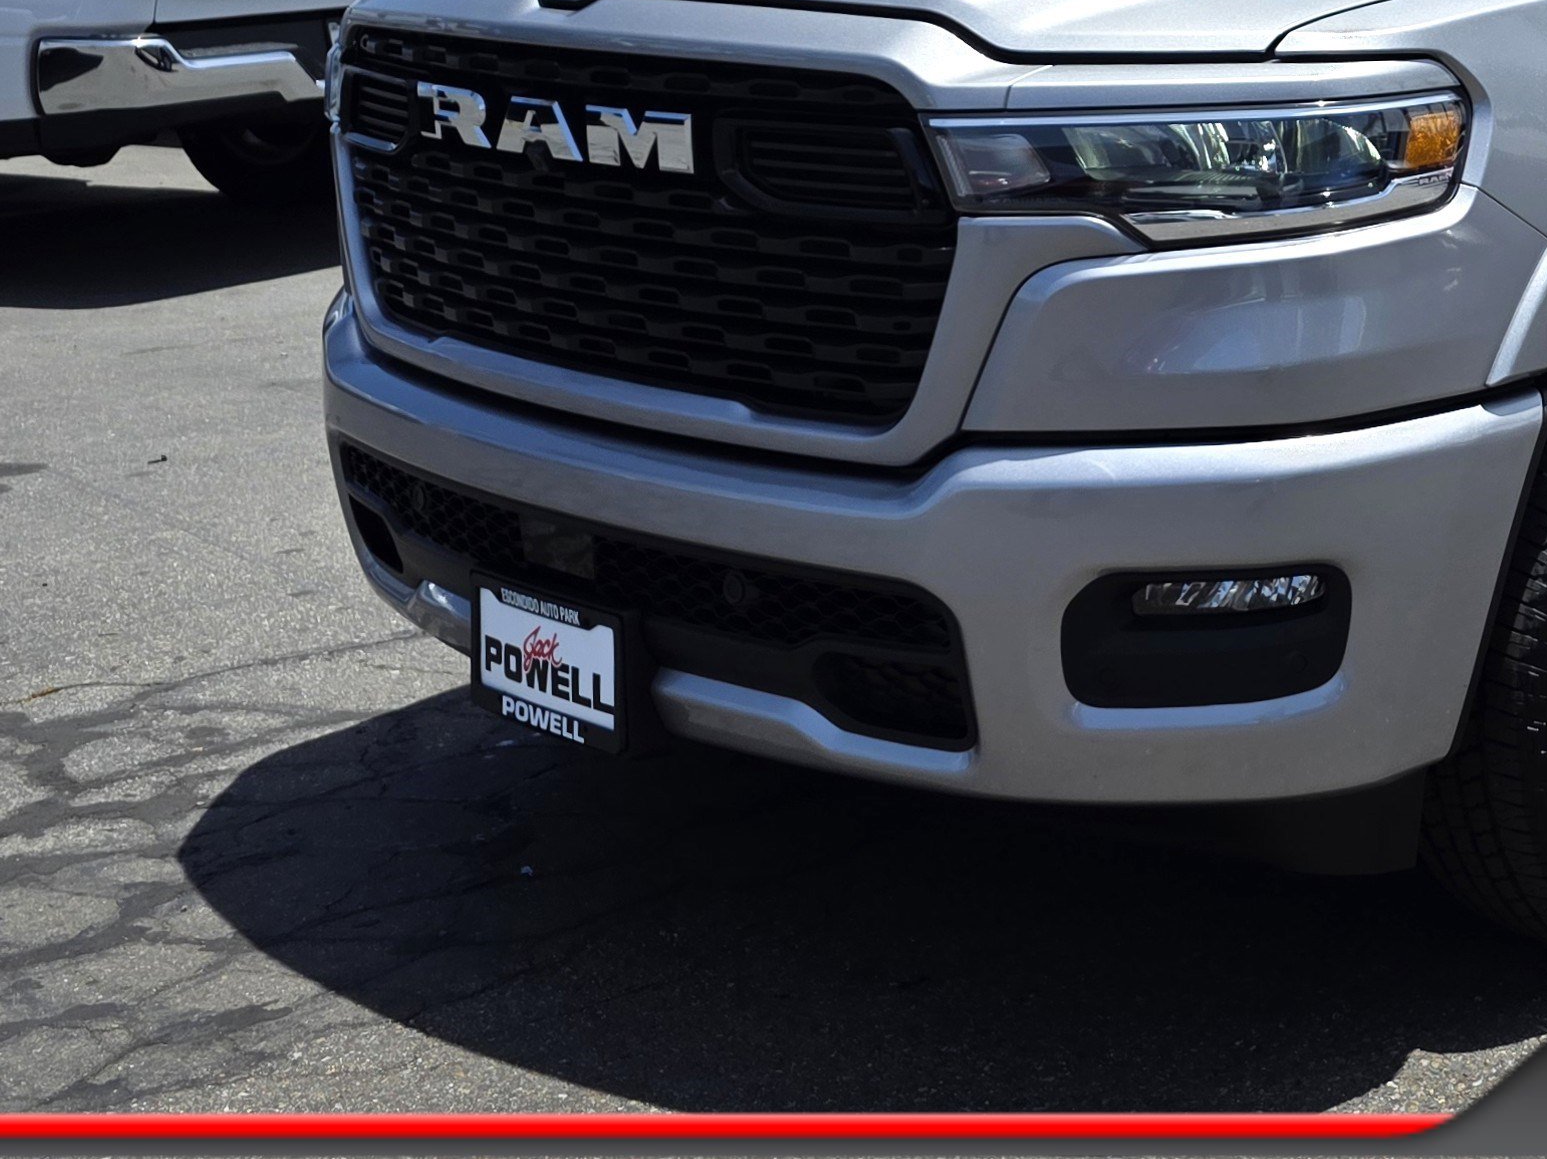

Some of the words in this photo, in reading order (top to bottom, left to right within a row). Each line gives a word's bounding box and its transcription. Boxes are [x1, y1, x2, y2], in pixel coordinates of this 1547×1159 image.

[416, 80, 695, 175] RAM
[501, 588, 539, 613] ESCONDIDO
[540, 602, 560, 620] AUTO
[559, 606, 580, 626] PARK
[522, 625, 563, 674] Jack
[485, 634, 615, 716] POWELL
[502, 695, 585, 744] POWELL
